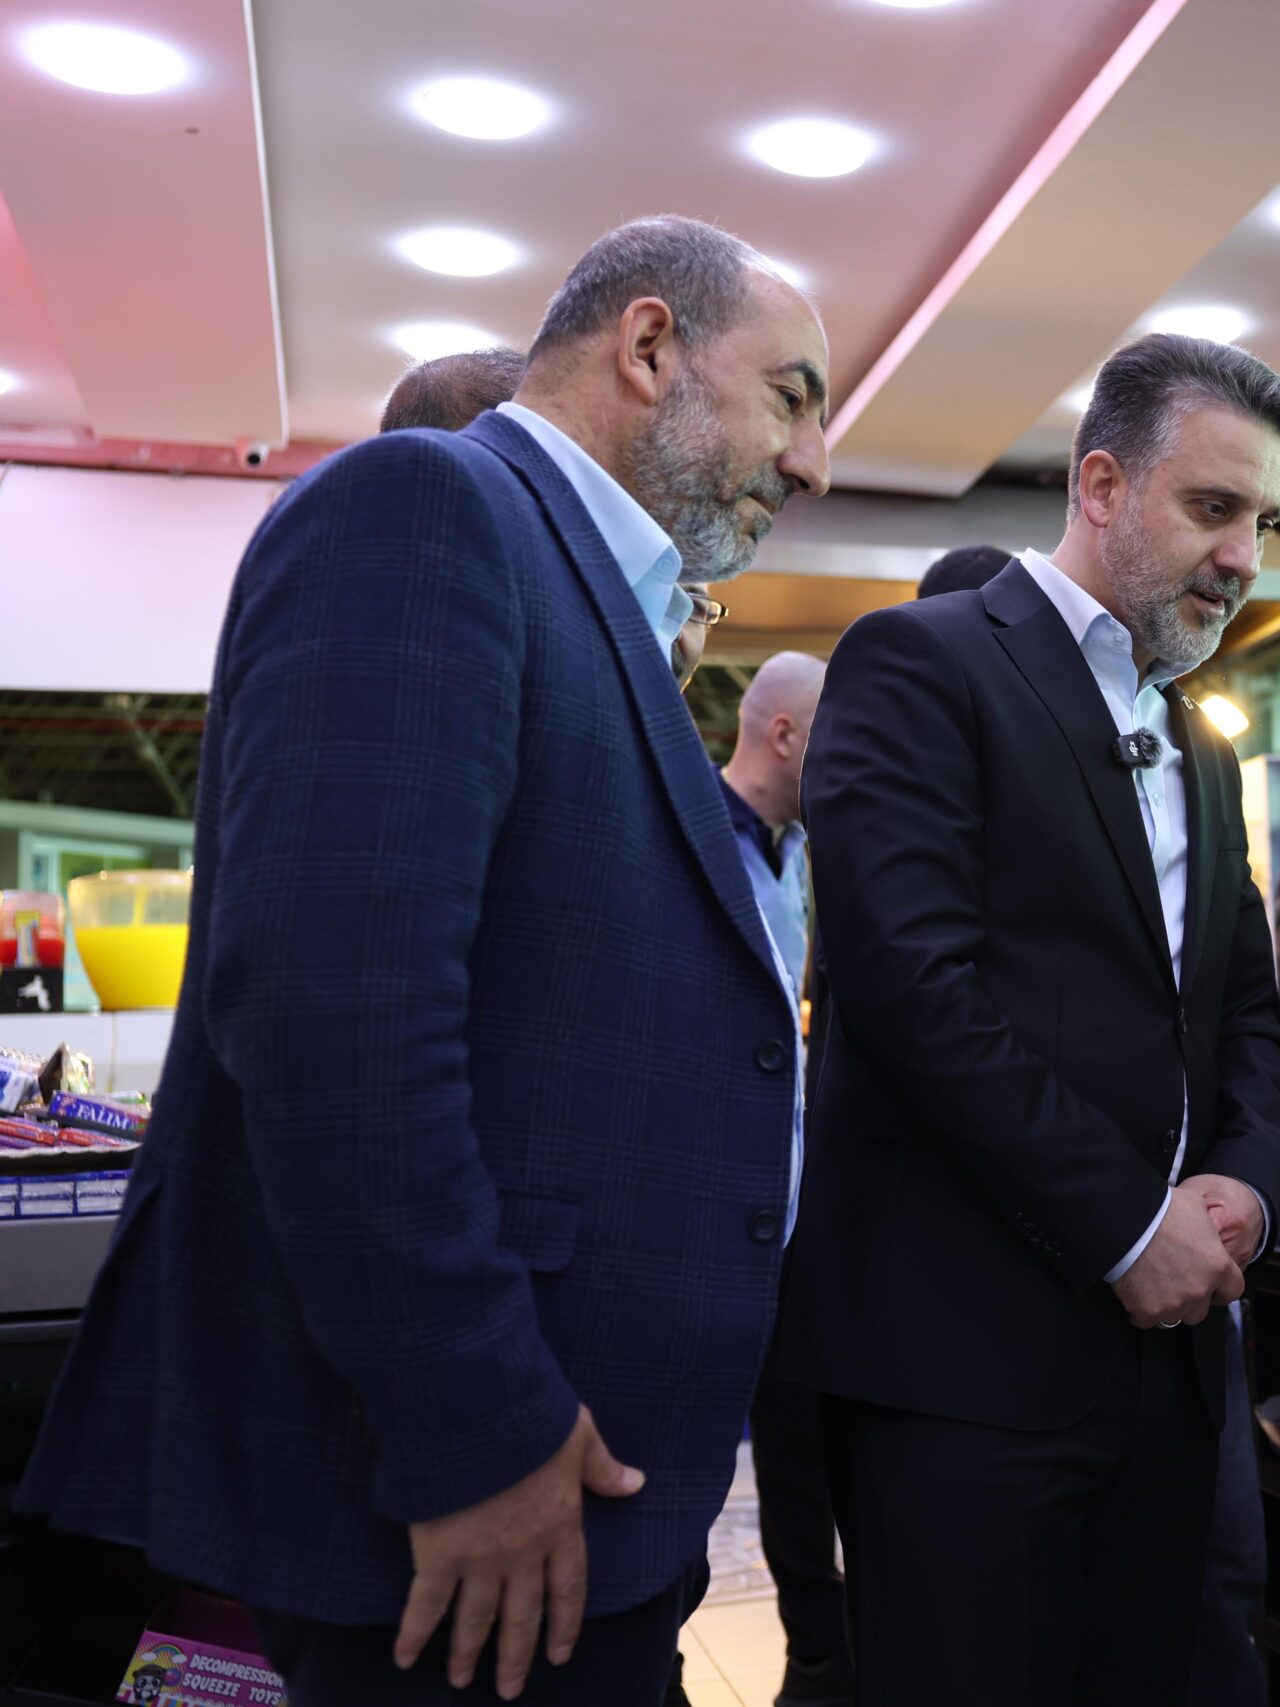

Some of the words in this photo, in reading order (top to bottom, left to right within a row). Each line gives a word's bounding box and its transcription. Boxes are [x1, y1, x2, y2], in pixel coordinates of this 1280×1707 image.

[76, 1101, 130, 1131] FALIM
[190, 1654, 284, 1688] DECOMPRESSION
[182, 1673, 241, 1697] SQUEEZE
[249, 1687, 282, 1706] TOYS
